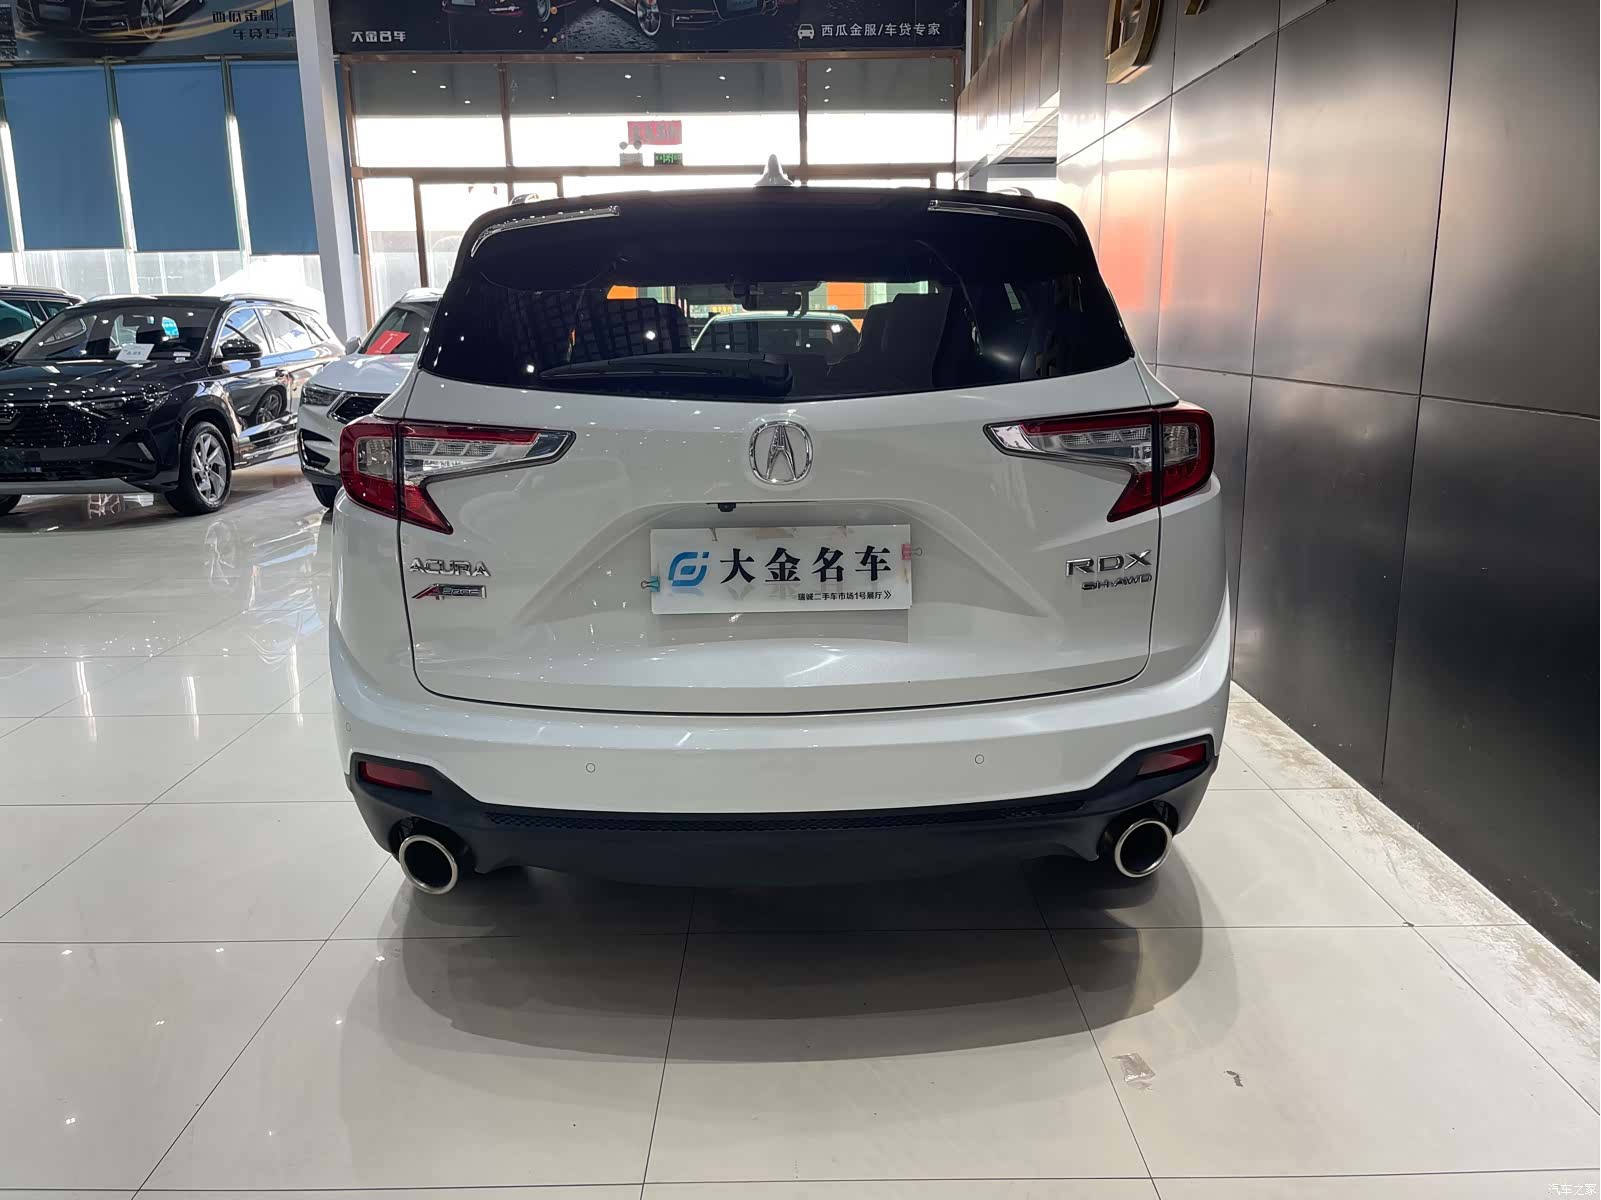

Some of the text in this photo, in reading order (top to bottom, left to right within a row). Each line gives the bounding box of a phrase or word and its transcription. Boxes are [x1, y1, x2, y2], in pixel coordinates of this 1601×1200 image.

[213, 9, 274, 23] 西瓜金服
[351, 31, 406, 43] 大金名车
[821, 23, 941, 37] 西瓜金服/车贷专家
[409, 557, 492, 577] ACURA
[720, 545, 892, 584] 大金名车
[1066, 549, 1152, 577] RDX
[1081, 573, 1153, 590] SH-AWD
[797, 591, 883, 601] 瑞诚二手车市场1号展厅
